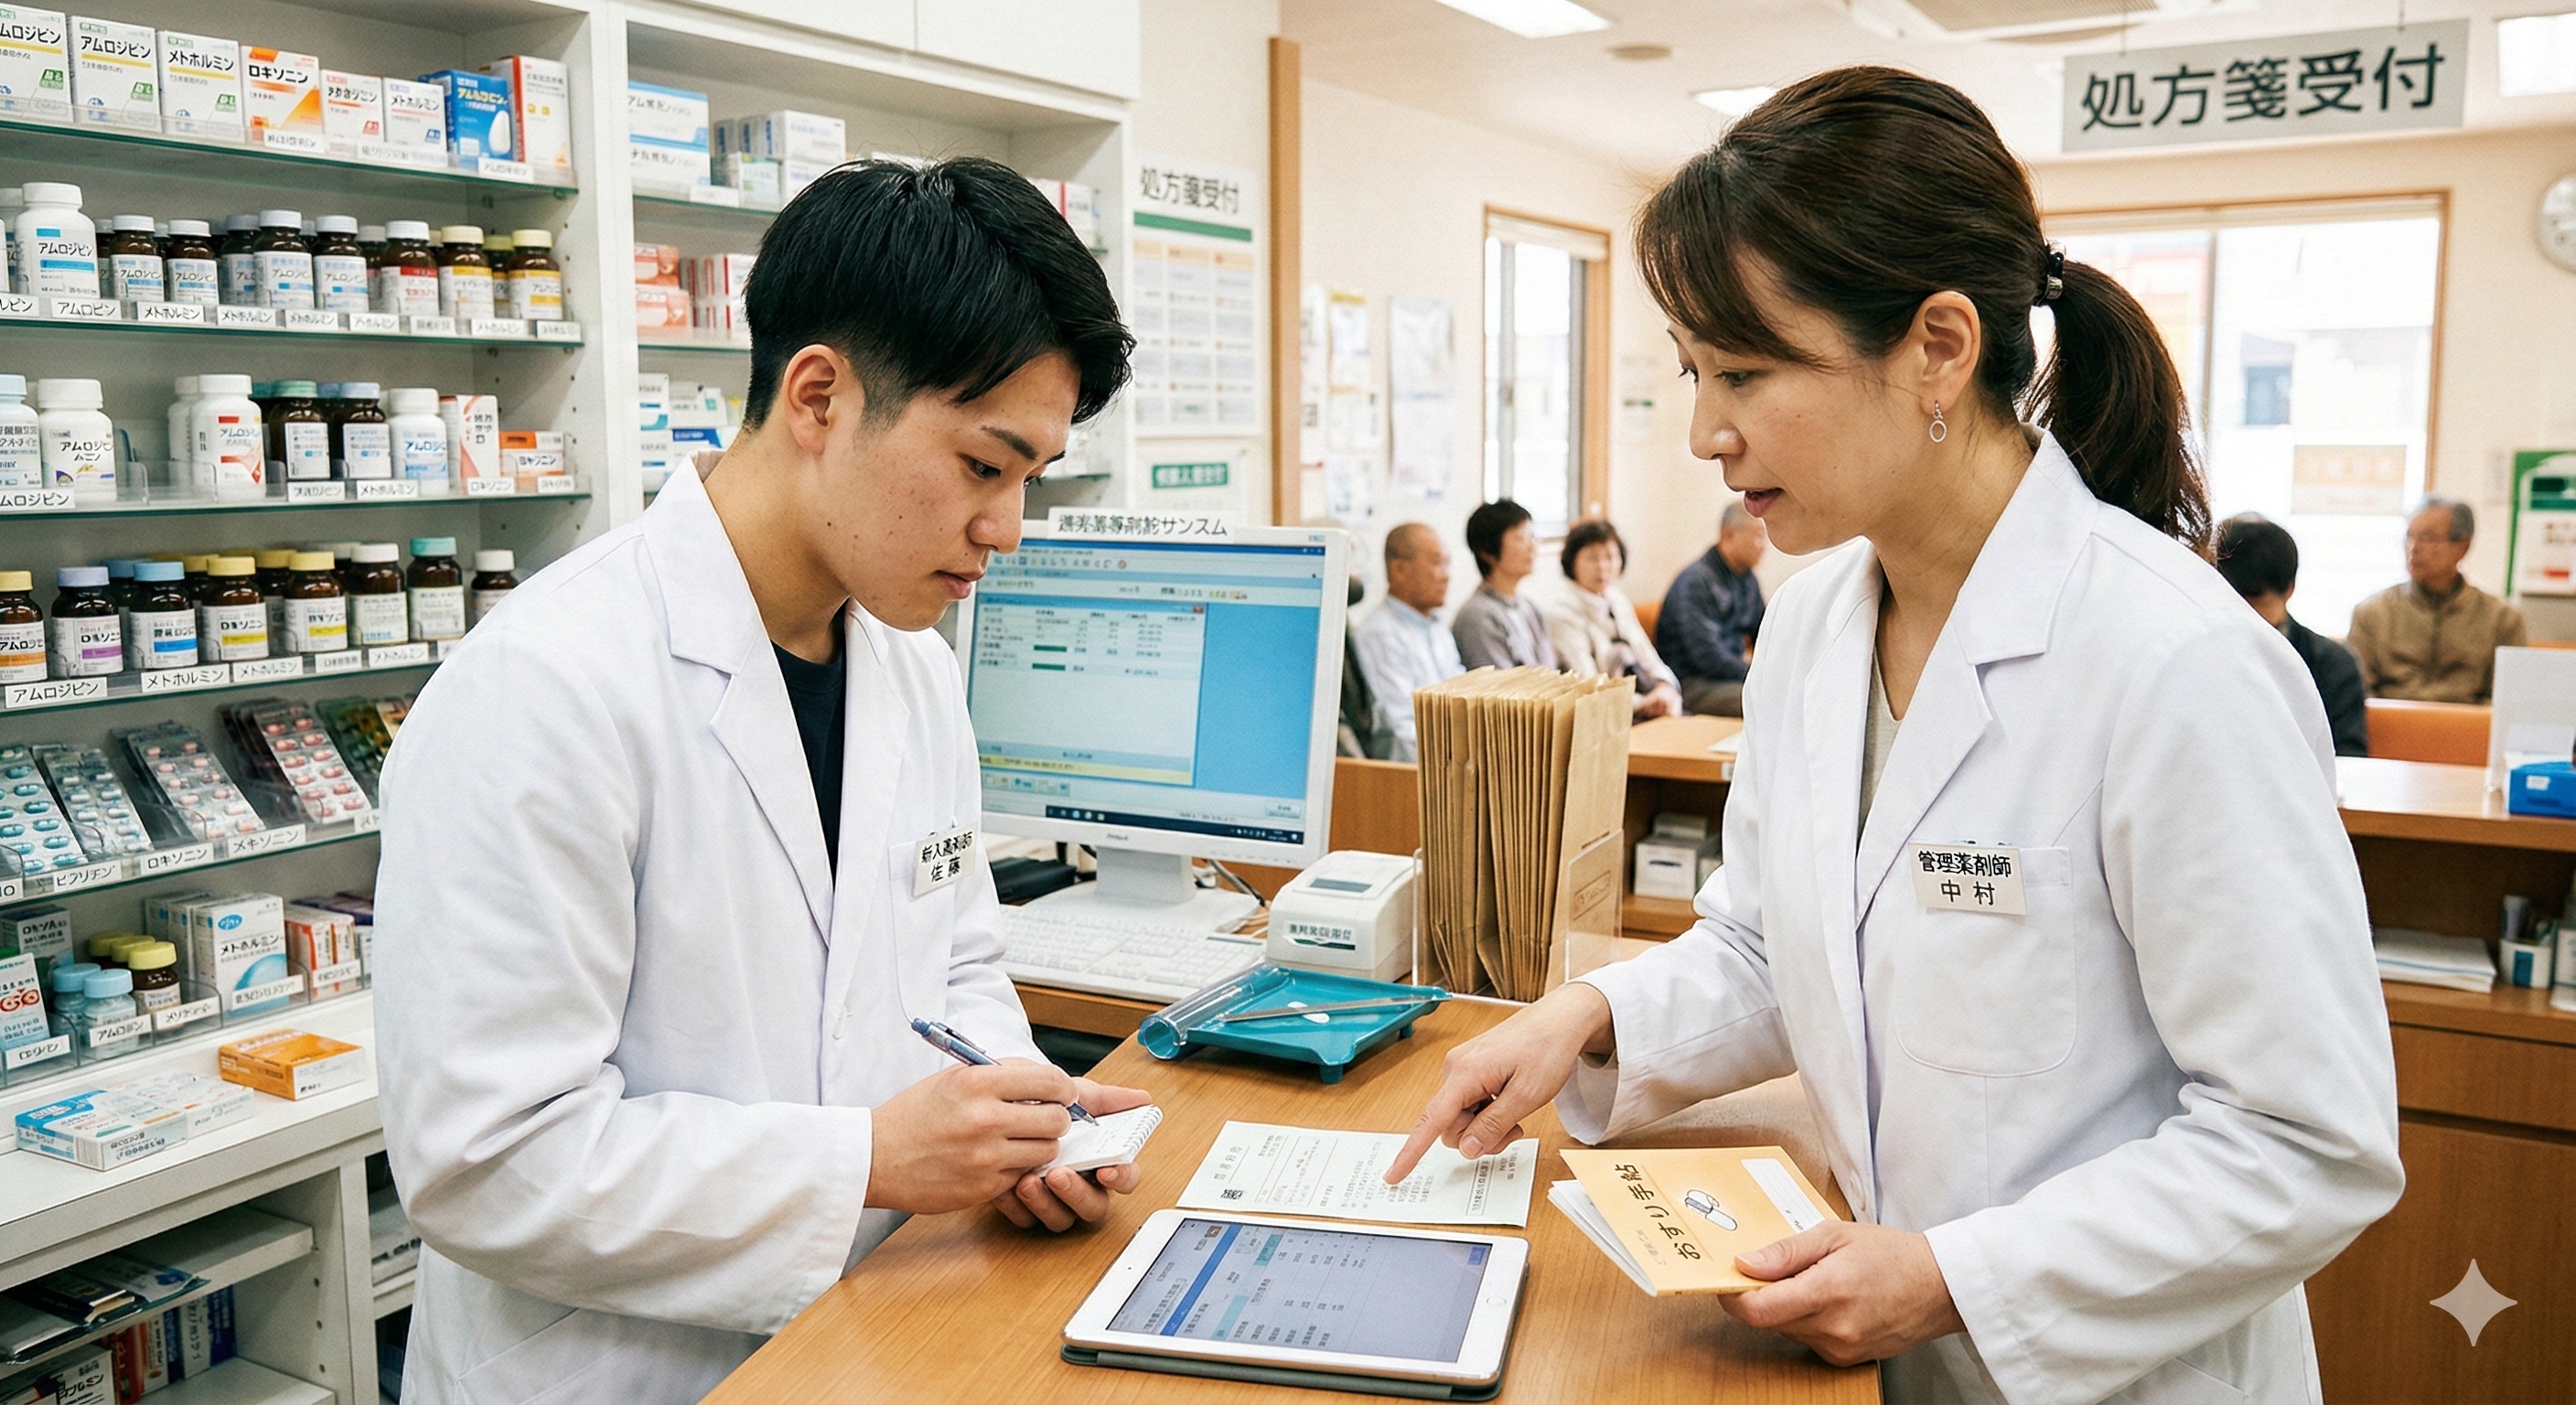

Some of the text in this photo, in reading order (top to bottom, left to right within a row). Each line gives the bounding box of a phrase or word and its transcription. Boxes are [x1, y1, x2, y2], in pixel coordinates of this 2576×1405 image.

[168, 49, 234, 71] メトホルミン
[249, 64, 308, 84] ロキソニン
[2081, 42, 2445, 133] 処方箋受付
[147, 670, 223, 689] メトホルミン
[147, 848, 209, 869] ロキソニン
[1917, 850, 2012, 878] 管理薬剤師
[1940, 879, 1995, 906] 中村
